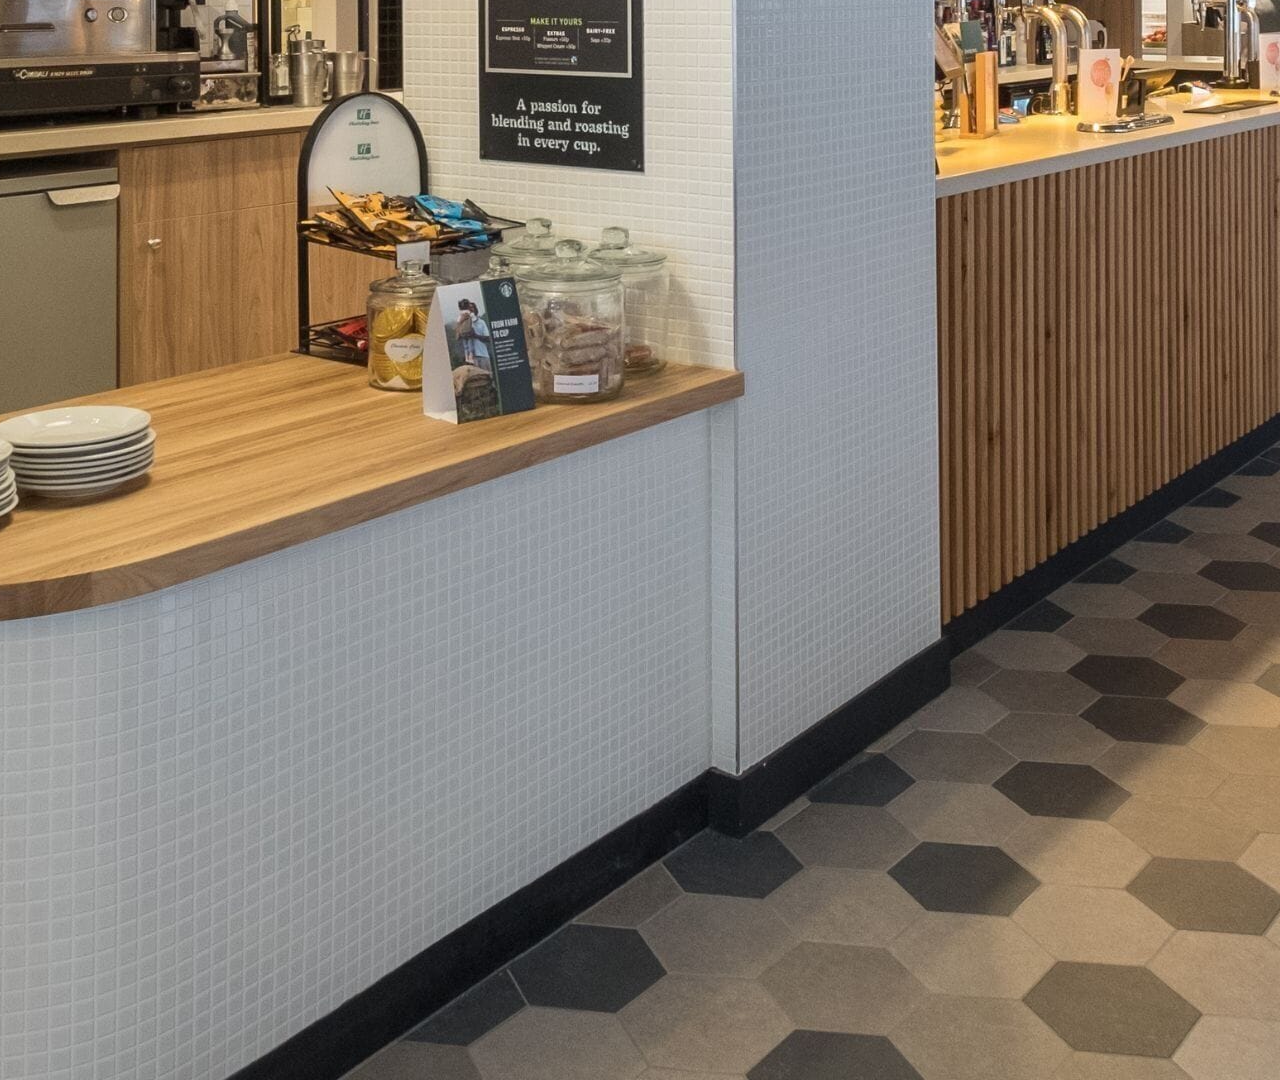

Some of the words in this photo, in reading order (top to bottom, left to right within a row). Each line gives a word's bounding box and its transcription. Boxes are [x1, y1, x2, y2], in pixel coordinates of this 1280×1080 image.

[530, 17, 549, 25] MAKE
[560, 18, 583, 26] YOURS
[516, 98, 527, 111] A
[530, 100, 578, 115] passion
[581, 100, 602, 115] for
[491, 113, 545, 133] blending
[547, 118, 572, 132] and
[575, 120, 630, 139] roasting
[517, 133, 531, 147] in
[533, 137, 570, 152] every
[573, 140, 601, 155] cup.
[500, 329, 509, 338] CUP
